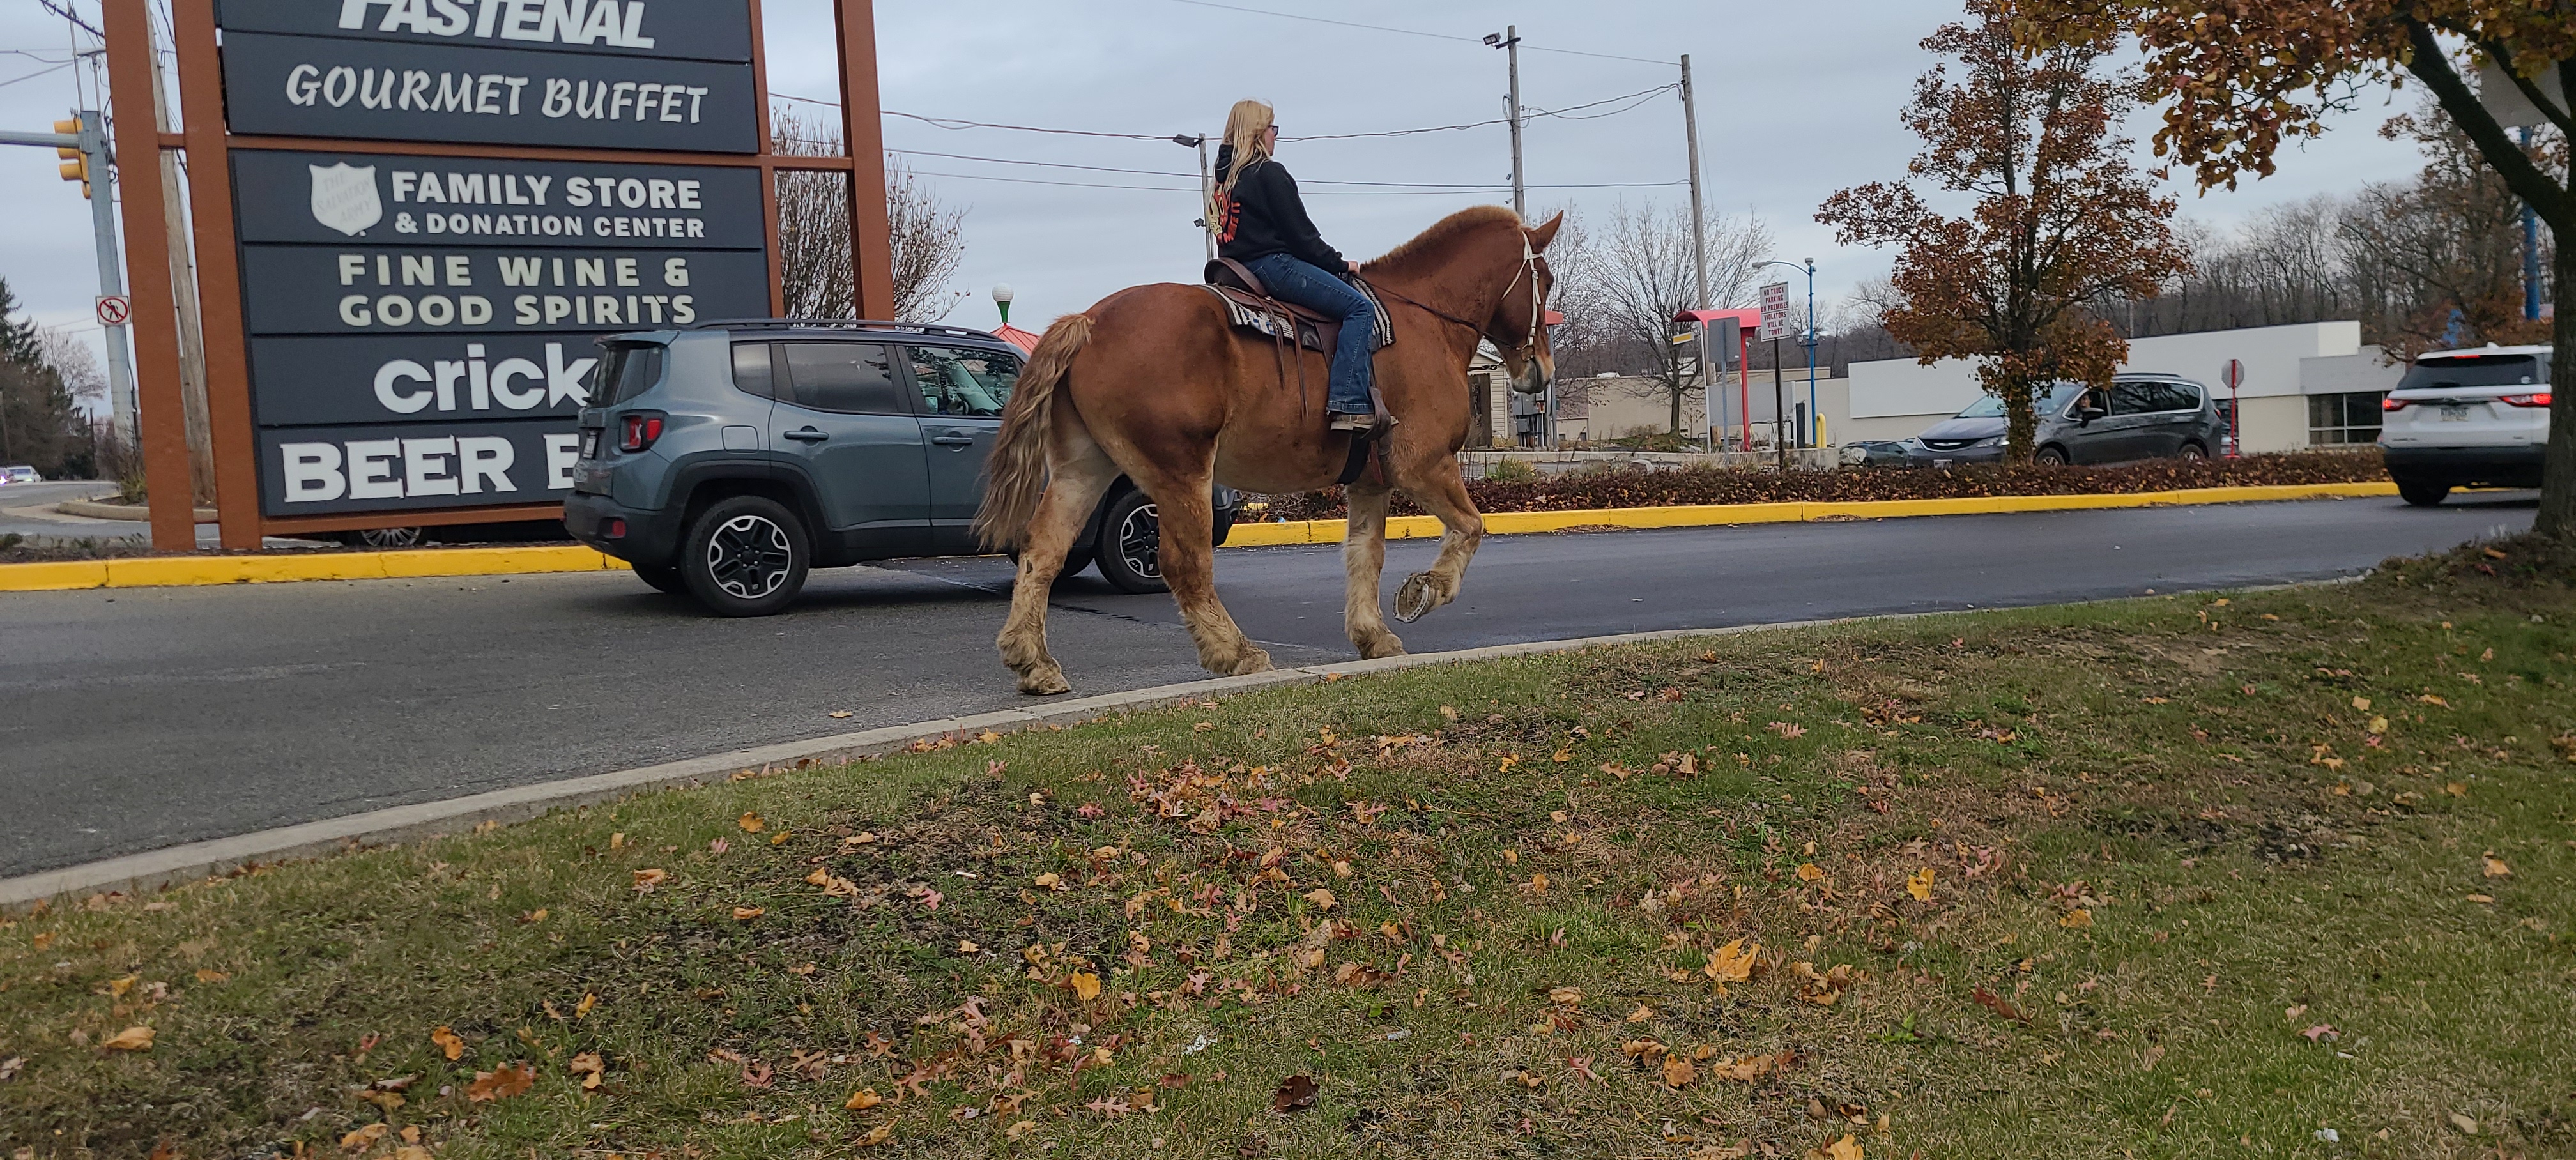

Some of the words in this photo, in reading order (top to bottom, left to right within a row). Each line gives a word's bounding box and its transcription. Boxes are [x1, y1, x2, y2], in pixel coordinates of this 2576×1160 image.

[339, 0, 655, 49] FASTENAL
[286, 64, 529, 116] GOURMET
[541, 78, 709, 124] BUFFET
[323, 171, 348, 192] THE
[392, 171, 552, 206] FAMILY
[566, 176, 702, 210] STORE
[339, 196, 372, 225] ARMY
[395, 212, 418, 233] &
[426, 213, 583, 236] DONATION
[594, 217, 705, 238] CENTER
[339, 255, 472, 286] FINE
[498, 257, 640, 286] WINE
[664, 257, 689, 287] &
[339, 295, 493, 326] GOOD
[514, 294, 696, 325] SPIRITS
[1766, 294, 1783, 304] PARKING
[1768, 301, 1788, 311] PREMISES
[1764, 311, 1786, 321] VIOLATORS
[1768, 328, 1782, 336] TOWED
[280, 435, 518, 503] BEER
